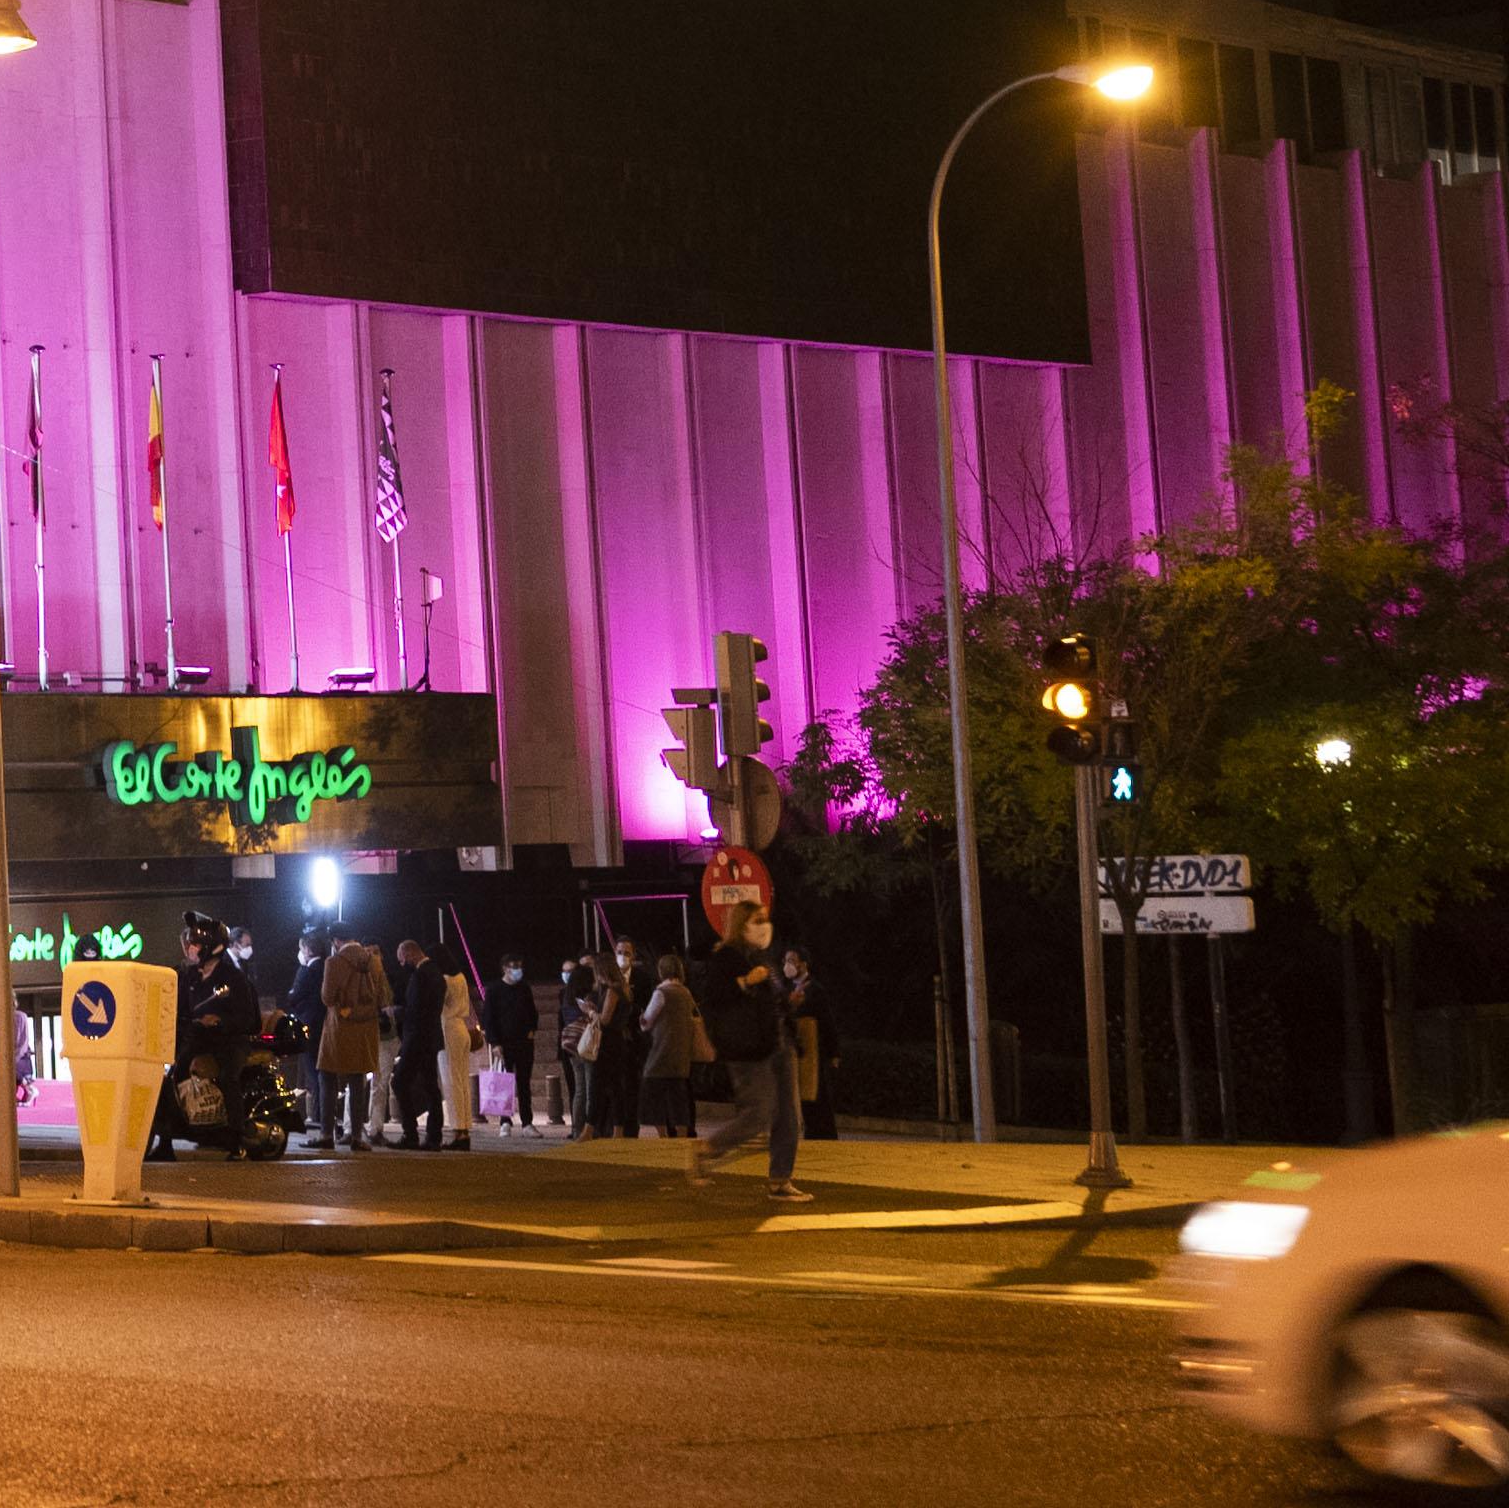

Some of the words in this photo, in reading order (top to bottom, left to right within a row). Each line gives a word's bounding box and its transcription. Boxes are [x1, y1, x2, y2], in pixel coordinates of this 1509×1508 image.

[111, 740, 155, 806] El
[153, 742, 244, 804] Corte
[248, 725, 372, 825] Inglés
